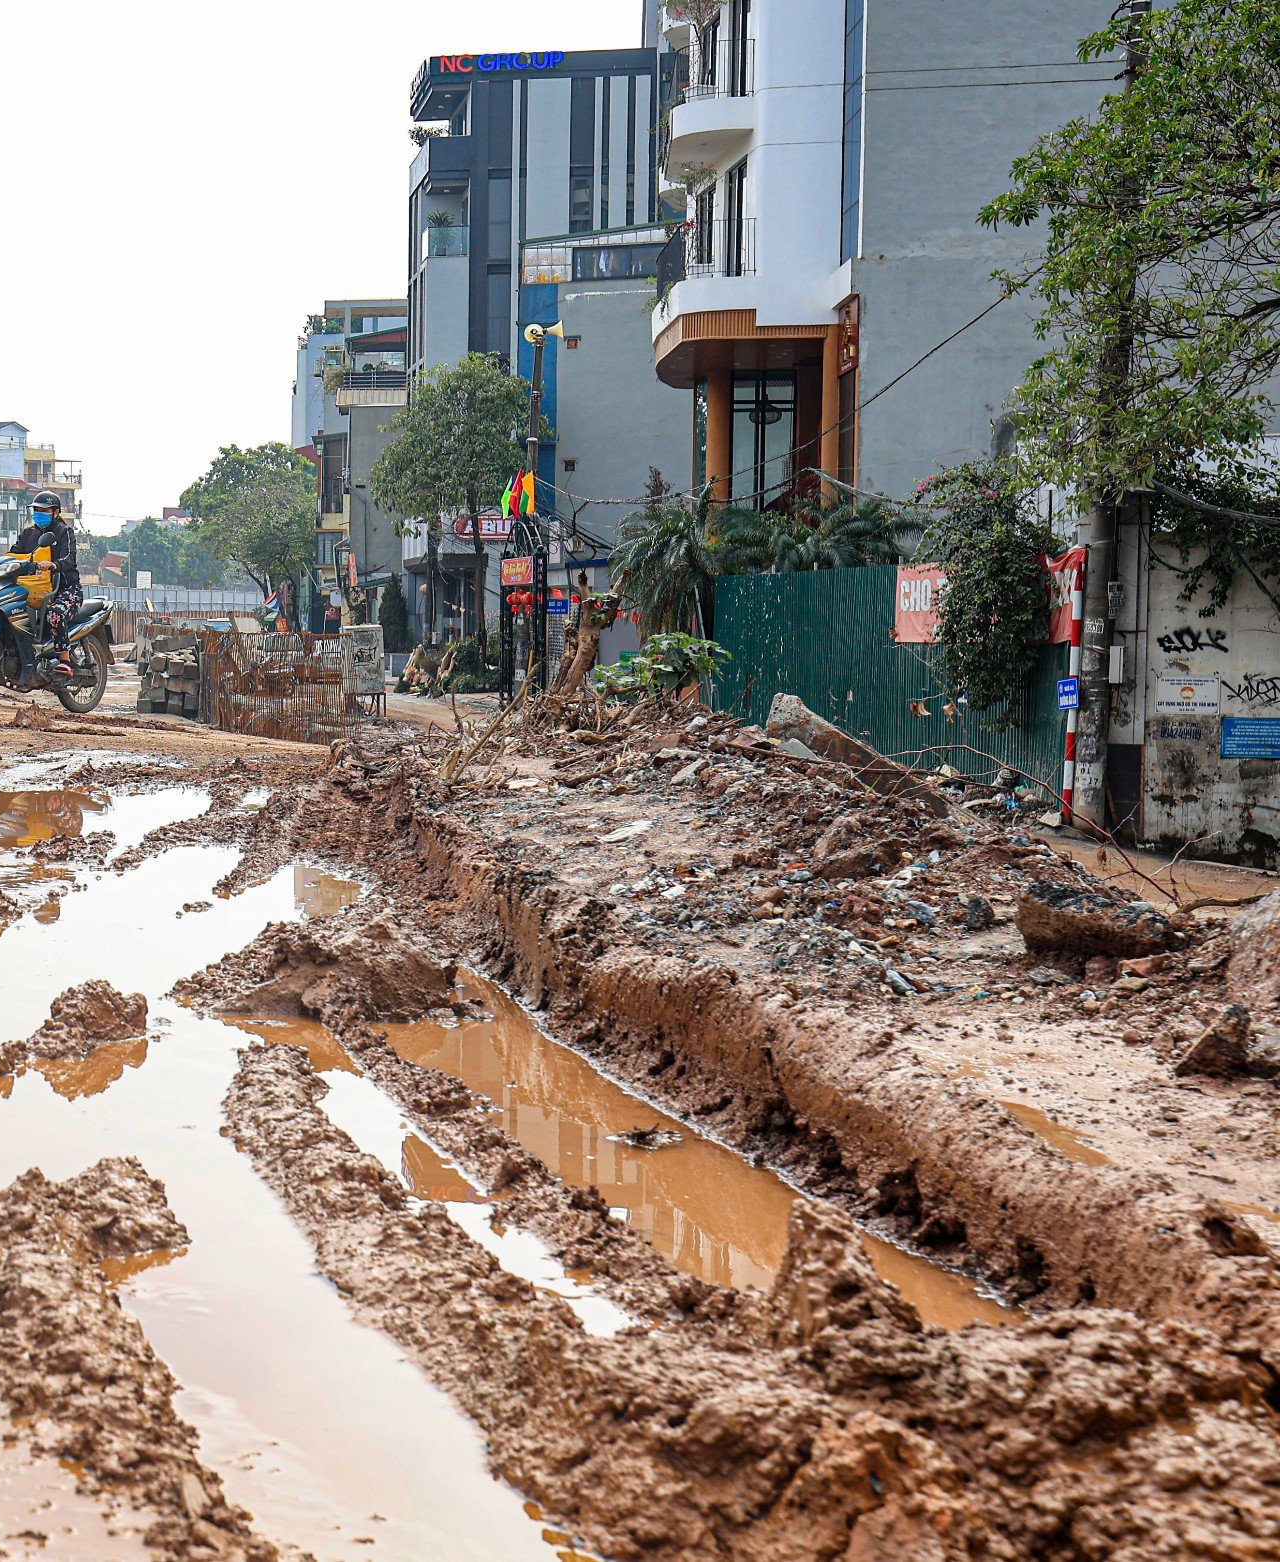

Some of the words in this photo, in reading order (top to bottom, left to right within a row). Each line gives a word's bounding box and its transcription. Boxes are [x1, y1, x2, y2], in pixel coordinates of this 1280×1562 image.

[440, 54, 474, 72] NC
[478, 51, 564, 72] GROUP
[900, 578, 933, 612] CHO
